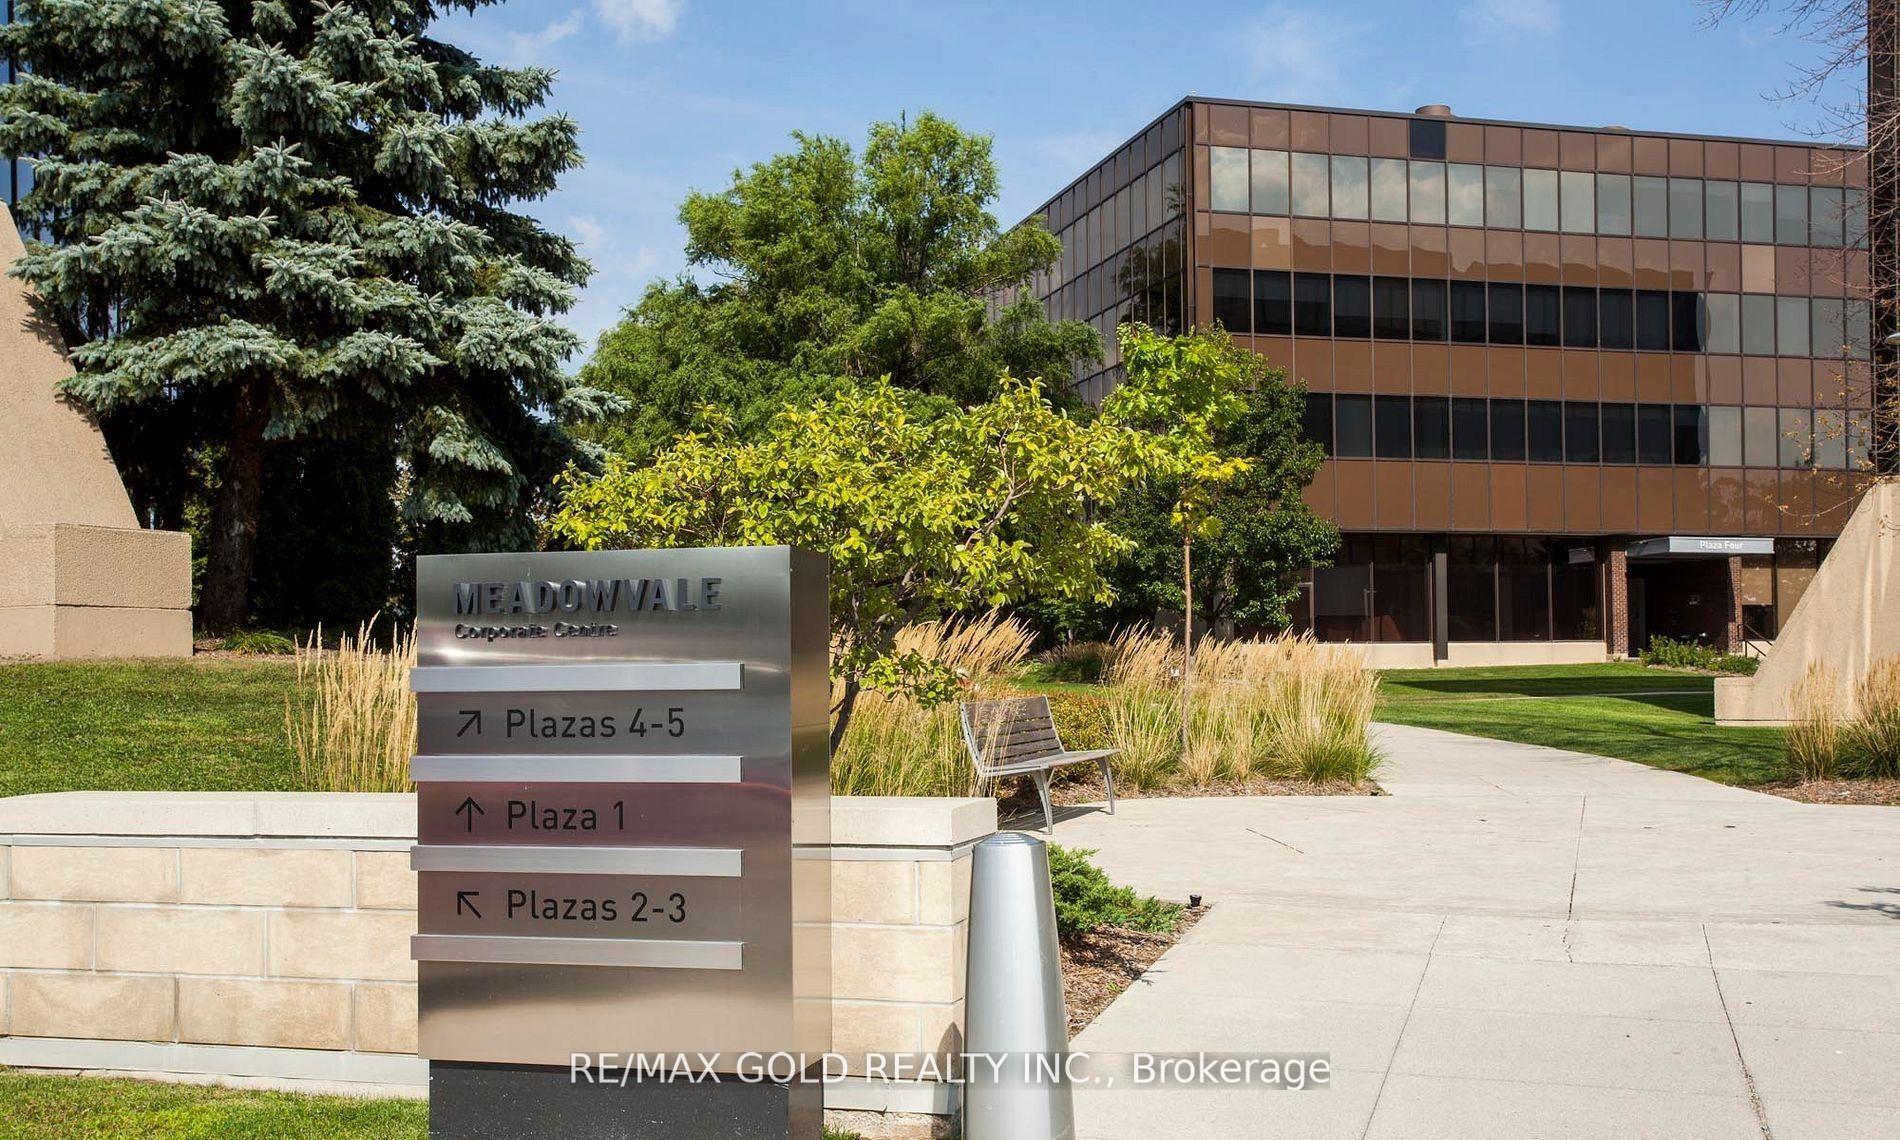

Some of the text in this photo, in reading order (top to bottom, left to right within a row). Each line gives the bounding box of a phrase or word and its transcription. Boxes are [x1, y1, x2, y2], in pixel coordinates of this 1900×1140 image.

[1700, 540, 1744, 550] Plaza Four
[453, 576, 723, 615] MEADOWVALE
[455, 621, 619, 642] Corporate Centre
[506, 707, 686, 738] Plazas 4-5
[507, 800, 625, 831] Plaza 1
[507, 889, 687, 924] Plazas 2-3
